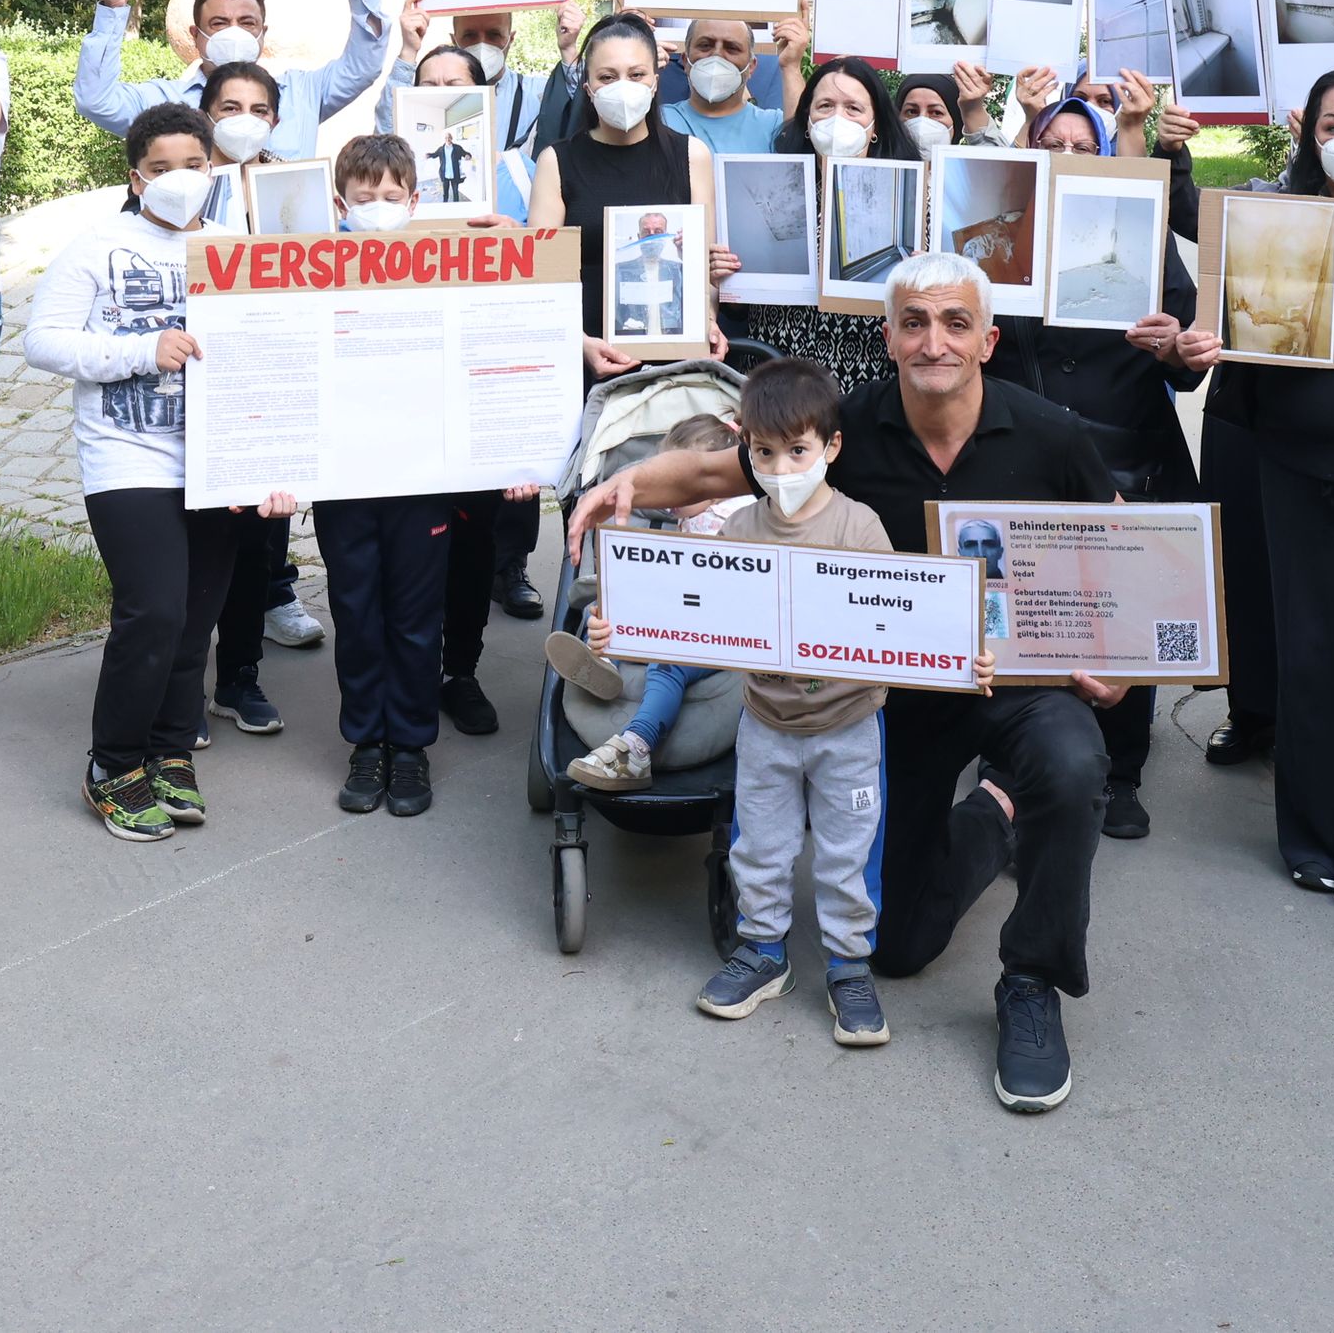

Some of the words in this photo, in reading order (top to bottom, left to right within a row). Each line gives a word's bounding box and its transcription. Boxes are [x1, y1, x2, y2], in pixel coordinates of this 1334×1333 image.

[1009, 520, 1105, 534] Behindertenpass
[611, 544, 685, 566] VEDAT
[692, 550, 771, 574] GÖKSU
[1012, 559, 1036, 567] Göksu
[817, 562, 946, 583] Bürgermeister
[1014, 589, 1071, 597] Geburtsdatum:
[1073, 590, 1112, 598] 04.02.1973
[849, 592, 913, 612] Ludwig
[1049, 600, 1100, 609] Behinderung:
[1015, 609, 1057, 617] ausgestellt
[1017, 619, 1039, 628] gültig
[1054, 620, 1092, 628] 16.12.2025
[617, 624, 772, 650] SCHWARZSCHIMMEL
[1017, 631, 1039, 639] gültig
[797, 642, 967, 670] SOZIALDIENST
